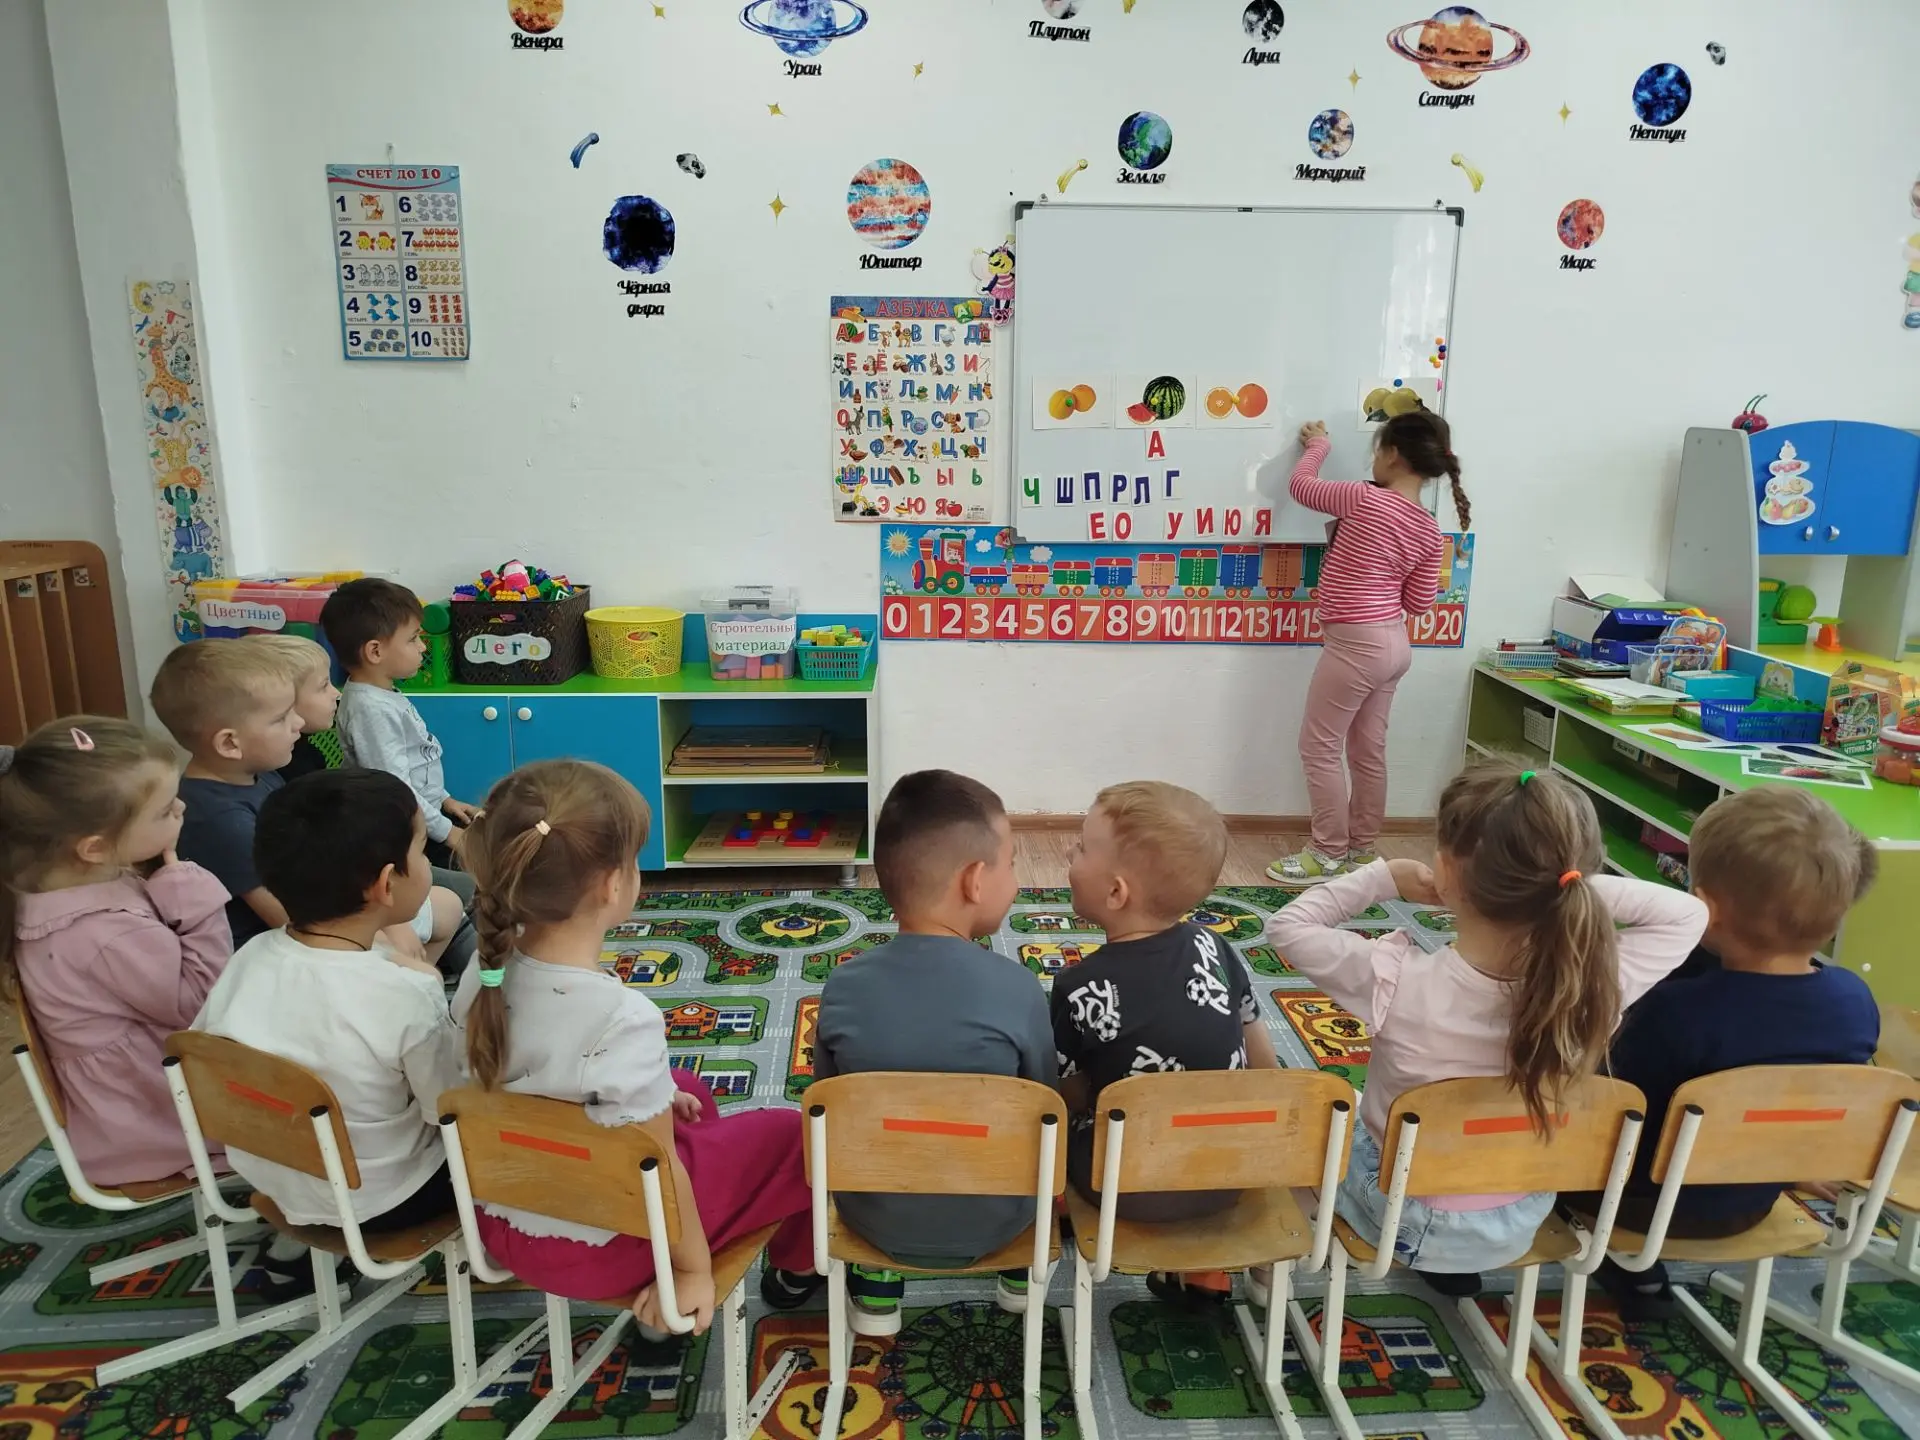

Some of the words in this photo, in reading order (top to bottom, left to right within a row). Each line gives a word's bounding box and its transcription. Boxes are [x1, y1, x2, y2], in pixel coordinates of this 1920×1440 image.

[1029, 21, 1090, 41] Плутон
[511, 32, 564, 51] Венера
[1242, 47, 1281, 66] Луна
[784, 60, 822, 78] Уран
[1418, 91, 1475, 109] Сатурн
[1630, 124, 1687, 143] Нептун
[397, 169, 416, 180] ДО
[421, 168, 441, 179] 10
[1117, 168, 1167, 184] Земля
[1294, 164, 1366, 183] Меркурий
[336, 195, 346, 212] 1
[399, 196, 412, 213] 6
[339, 230, 352, 247] 2
[401, 230, 414, 248] 7
[859, 254, 922, 271] Юпитер
[1560, 254, 1597, 272] Марс
[343, 264, 355, 281] 3
[405, 265, 418, 281] 8
[617, 280, 671, 298] Чёрная
[346, 297, 360, 313] 4
[409, 297, 421, 314] 9
[627, 304, 665, 318] дыра
[876, 299, 949, 318] АЗБУКА
[349, 330, 361, 347] 5
[411, 331, 432, 347] 10
[836, 323, 850, 341] А
[868, 324, 880, 342] Б
[911, 324, 922, 342] В
[934, 324, 947, 342] Г
[964, 324, 981, 345] Д
[846, 352, 857, 371] Е
[877, 349, 888, 372] Ё
[906, 354, 927, 372] Ж
[944, 354, 955, 371] З
[964, 354, 978, 372] И
[840, 378, 853, 398] Й
[865, 381, 878, 399] К
[899, 380, 915, 397] Л
[936, 383, 953, 401] М
[968, 383, 982, 401] Н
[837, 409, 850, 427] О
[868, 410, 881, 428] П
[901, 410, 914, 428] Р
[931, 411, 944, 428] С
[965, 412, 978, 430] Т
[840, 438, 854, 456] У
[870, 439, 884, 458] Ф
[903, 439, 918, 456] Х
[941, 437, 958, 459] Ц
[974, 437, 986, 454] Ч
[1148, 431, 1165, 458] А
[841, 466, 860, 484] Ш
[870, 467, 893, 487] Щ
[907, 467, 920, 485] Ъ
[937, 468, 954, 486] Ы
[972, 468, 983, 486] Ь
[1023, 478, 1040, 504] Ч
[1057, 477, 1073, 503] Ш
[1084, 472, 1101, 500] П
[1112, 475, 1127, 502] Р
[1134, 476, 1150, 504] Л
[1166, 470, 1180, 497] Г
[878, 496, 890, 514] Э
[907, 497, 926, 515] Ю
[935, 498, 947, 515] Я
[1090, 512, 1106, 539] Е
[1115, 512, 1132, 540] О
[1167, 512, 1184, 540] У
[1196, 508, 1213, 535] И
[1224, 509, 1241, 536] Ю
[1254, 509, 1272, 536] Я
[987, 567, 991, 575] 1
[1070, 561, 1075, 569] 3
[207, 603, 280, 620] Цветные
[710, 622, 796, 635] Строительны
[886, 603, 907, 633] 0
[918, 603, 932, 633] 1
[942, 603, 962, 634] 2
[970, 604, 990, 635] 3
[995, 604, 1018, 635] 4
[1024, 605, 1045, 635] 5
[1051, 604, 1074, 636] 6
[1080, 606, 1100, 636] 7
[1106, 605, 1128, 636] 8
[1135, 605, 1157, 636] 9
[1161, 606, 1187, 637] 10
[1190, 606, 1212, 637] 11
[1216, 606, 1242, 637] 12
[1245, 606, 1270, 638] 13
[1273, 607, 1297, 638] 14
[1413, 610, 1435, 640] 19
[1436, 610, 1462, 640] 20
[472, 639, 540, 656] Лего
[715, 642, 786, 653] материал
[1193, 928, 1232, 1015] PLAY
[1067, 979, 1119, 1028] JOY
